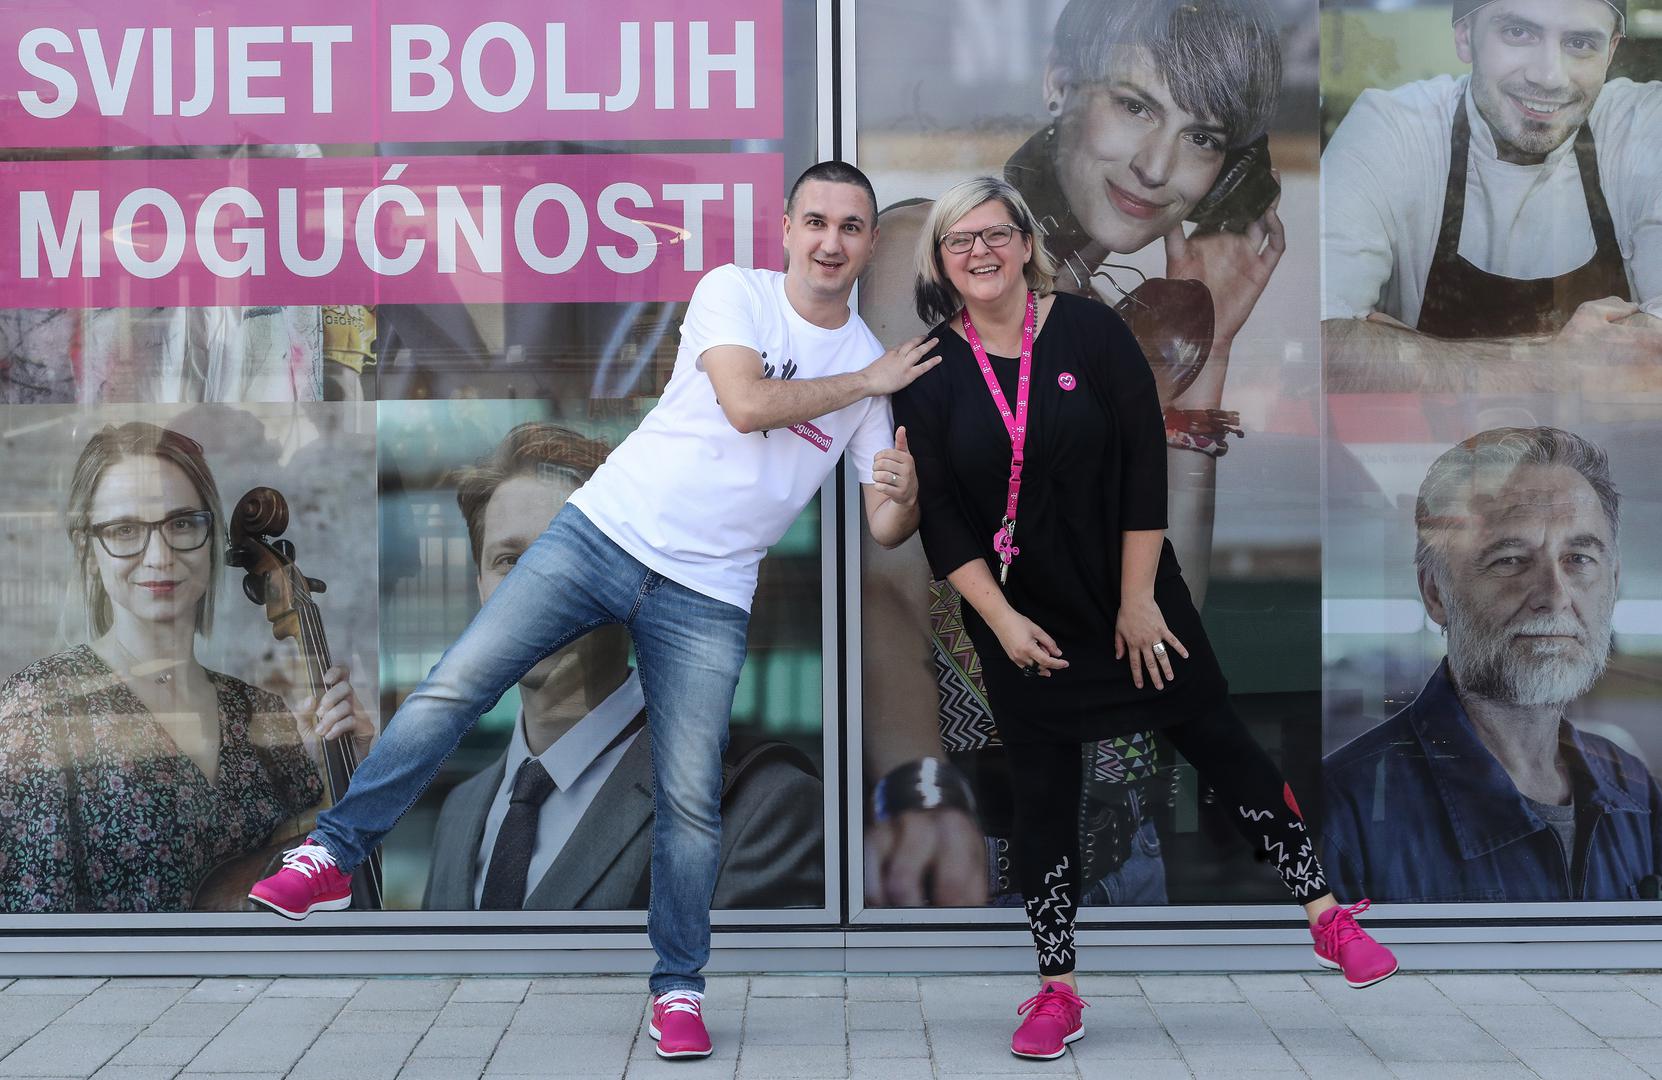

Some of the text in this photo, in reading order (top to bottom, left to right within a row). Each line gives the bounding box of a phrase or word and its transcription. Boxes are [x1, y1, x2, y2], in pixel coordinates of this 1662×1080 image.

[18, 21, 756, 119] SVIJET BOLJIH
[20, 164, 753, 280] MOGUĆNOSTI
[793, 422, 832, 449] ogucnosti
